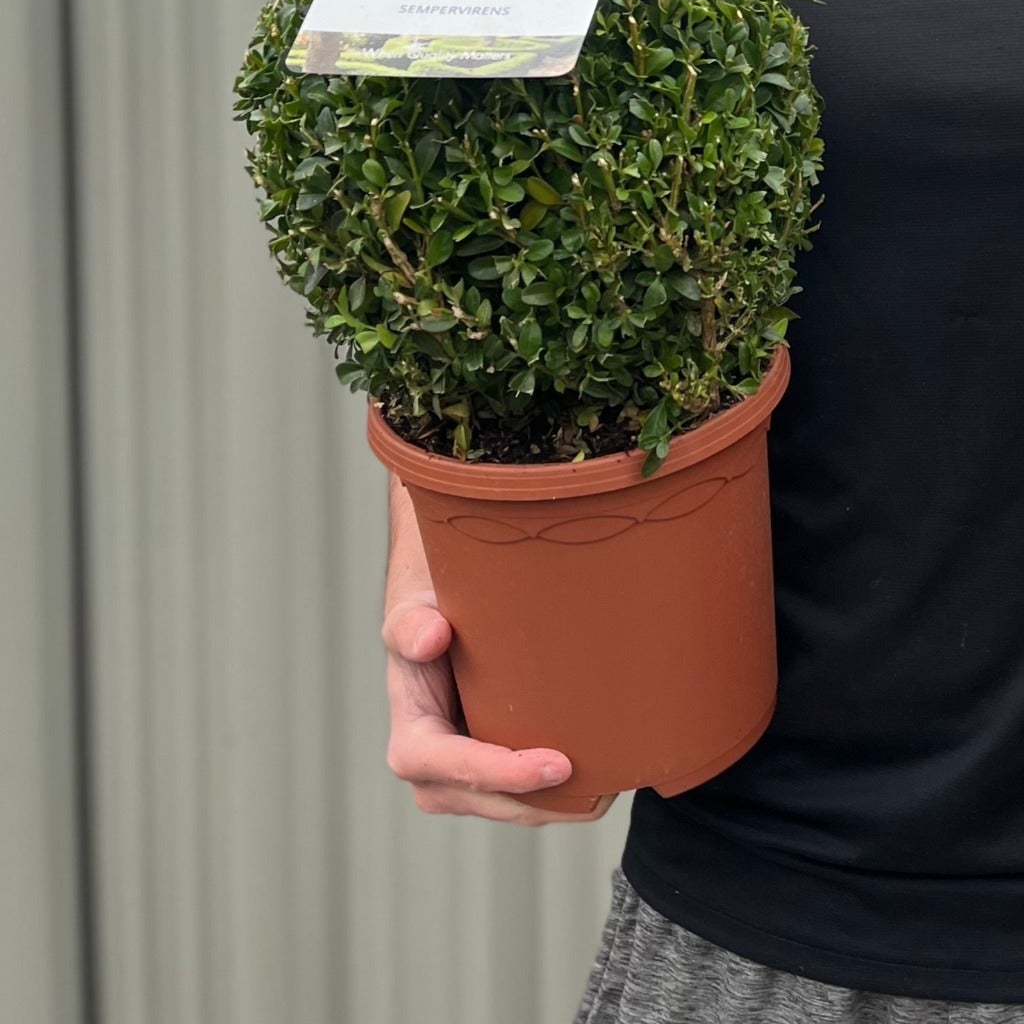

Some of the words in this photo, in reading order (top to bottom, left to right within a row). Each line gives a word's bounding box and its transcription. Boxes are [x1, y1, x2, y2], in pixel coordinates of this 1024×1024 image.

[398, 4, 512, 16] SEMPERVIRENS
[406, 42, 456, 63] Quality
[460, 51, 511, 61] Matters
